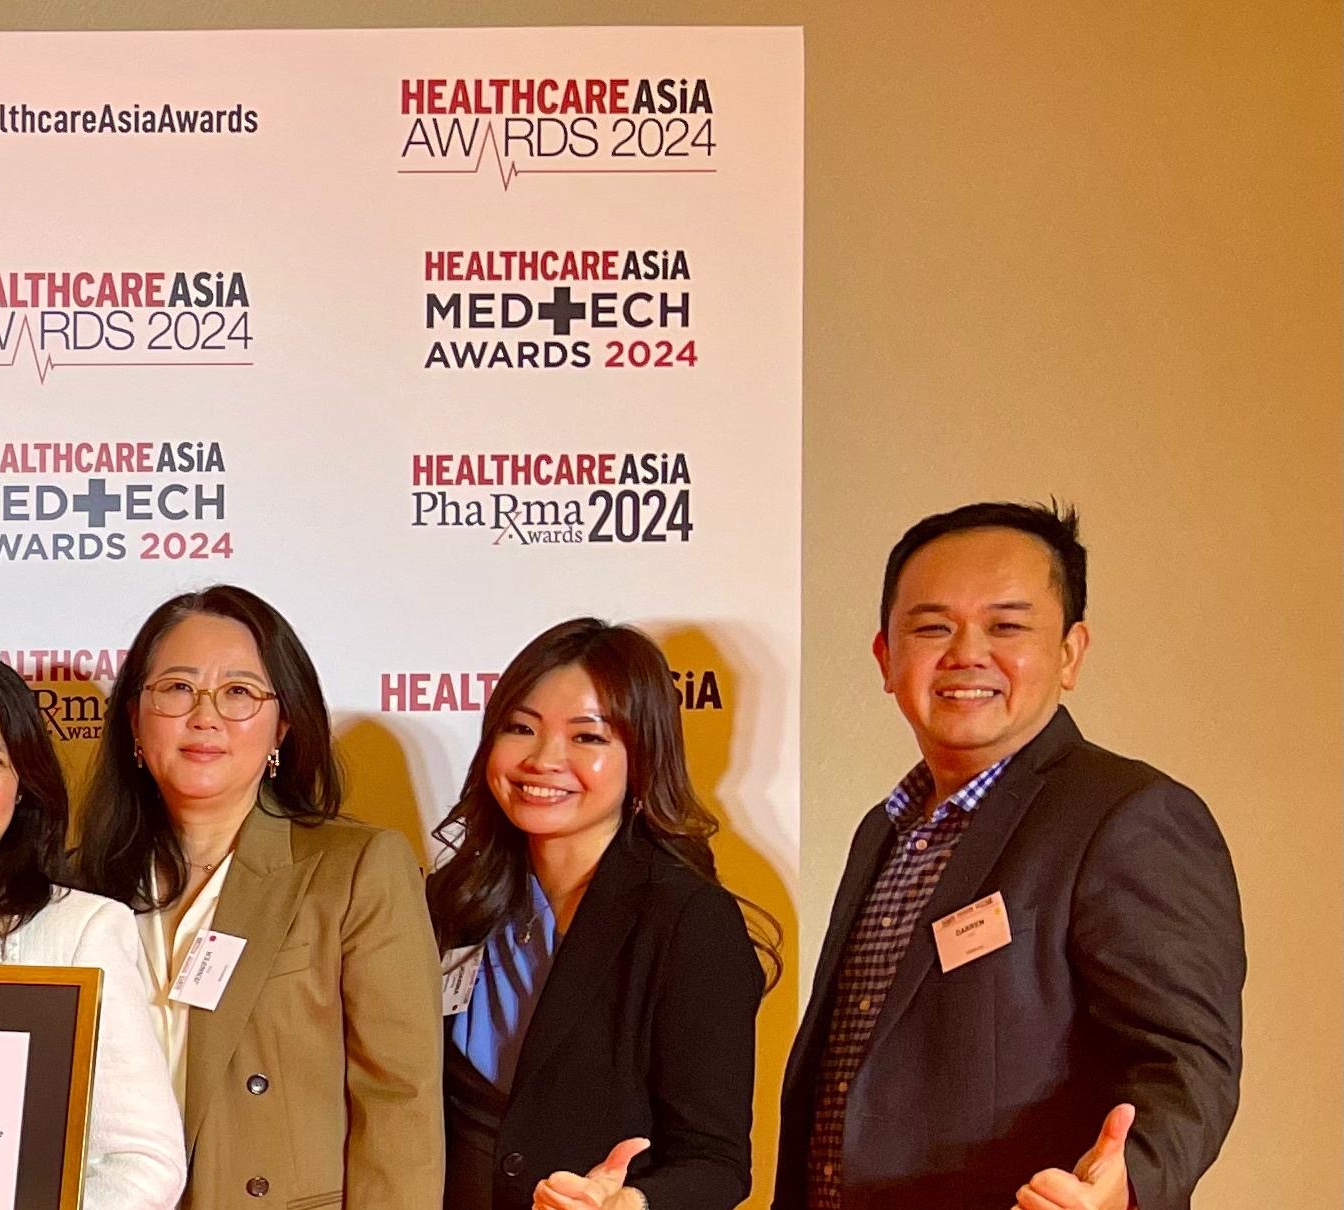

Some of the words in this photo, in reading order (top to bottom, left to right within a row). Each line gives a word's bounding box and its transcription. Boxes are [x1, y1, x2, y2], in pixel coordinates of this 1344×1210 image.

[611, 118, 717, 159] 2024
[147, 310, 254, 351] 2024
[424, 341, 591, 368] AWARDS
[605, 340, 698, 367] 2024
[588, 489, 693, 542] 2024
[140, 532, 233, 559] 2024
